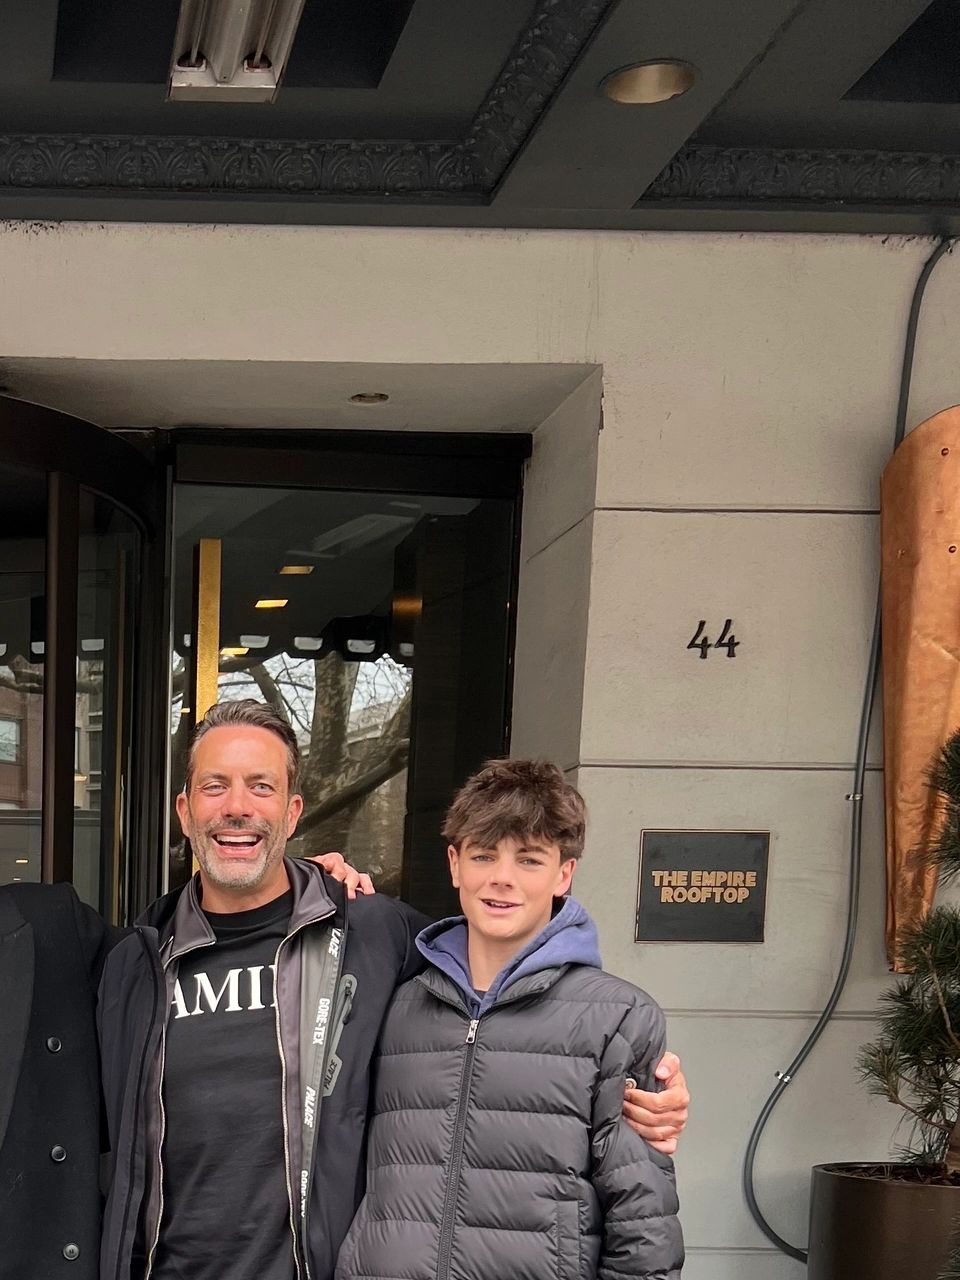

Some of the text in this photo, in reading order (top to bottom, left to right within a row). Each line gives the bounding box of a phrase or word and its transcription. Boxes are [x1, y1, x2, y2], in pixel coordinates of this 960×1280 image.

[687, 619, 740, 659] 44
[651, 870, 756, 887] THE EMPIRE
[660, 886, 749, 903] ROOFTOP
[328, 928, 342, 958] LACE
[312, 997, 331, 1046] GORE-TEX
[304, 1085, 316, 1129] PALACE
